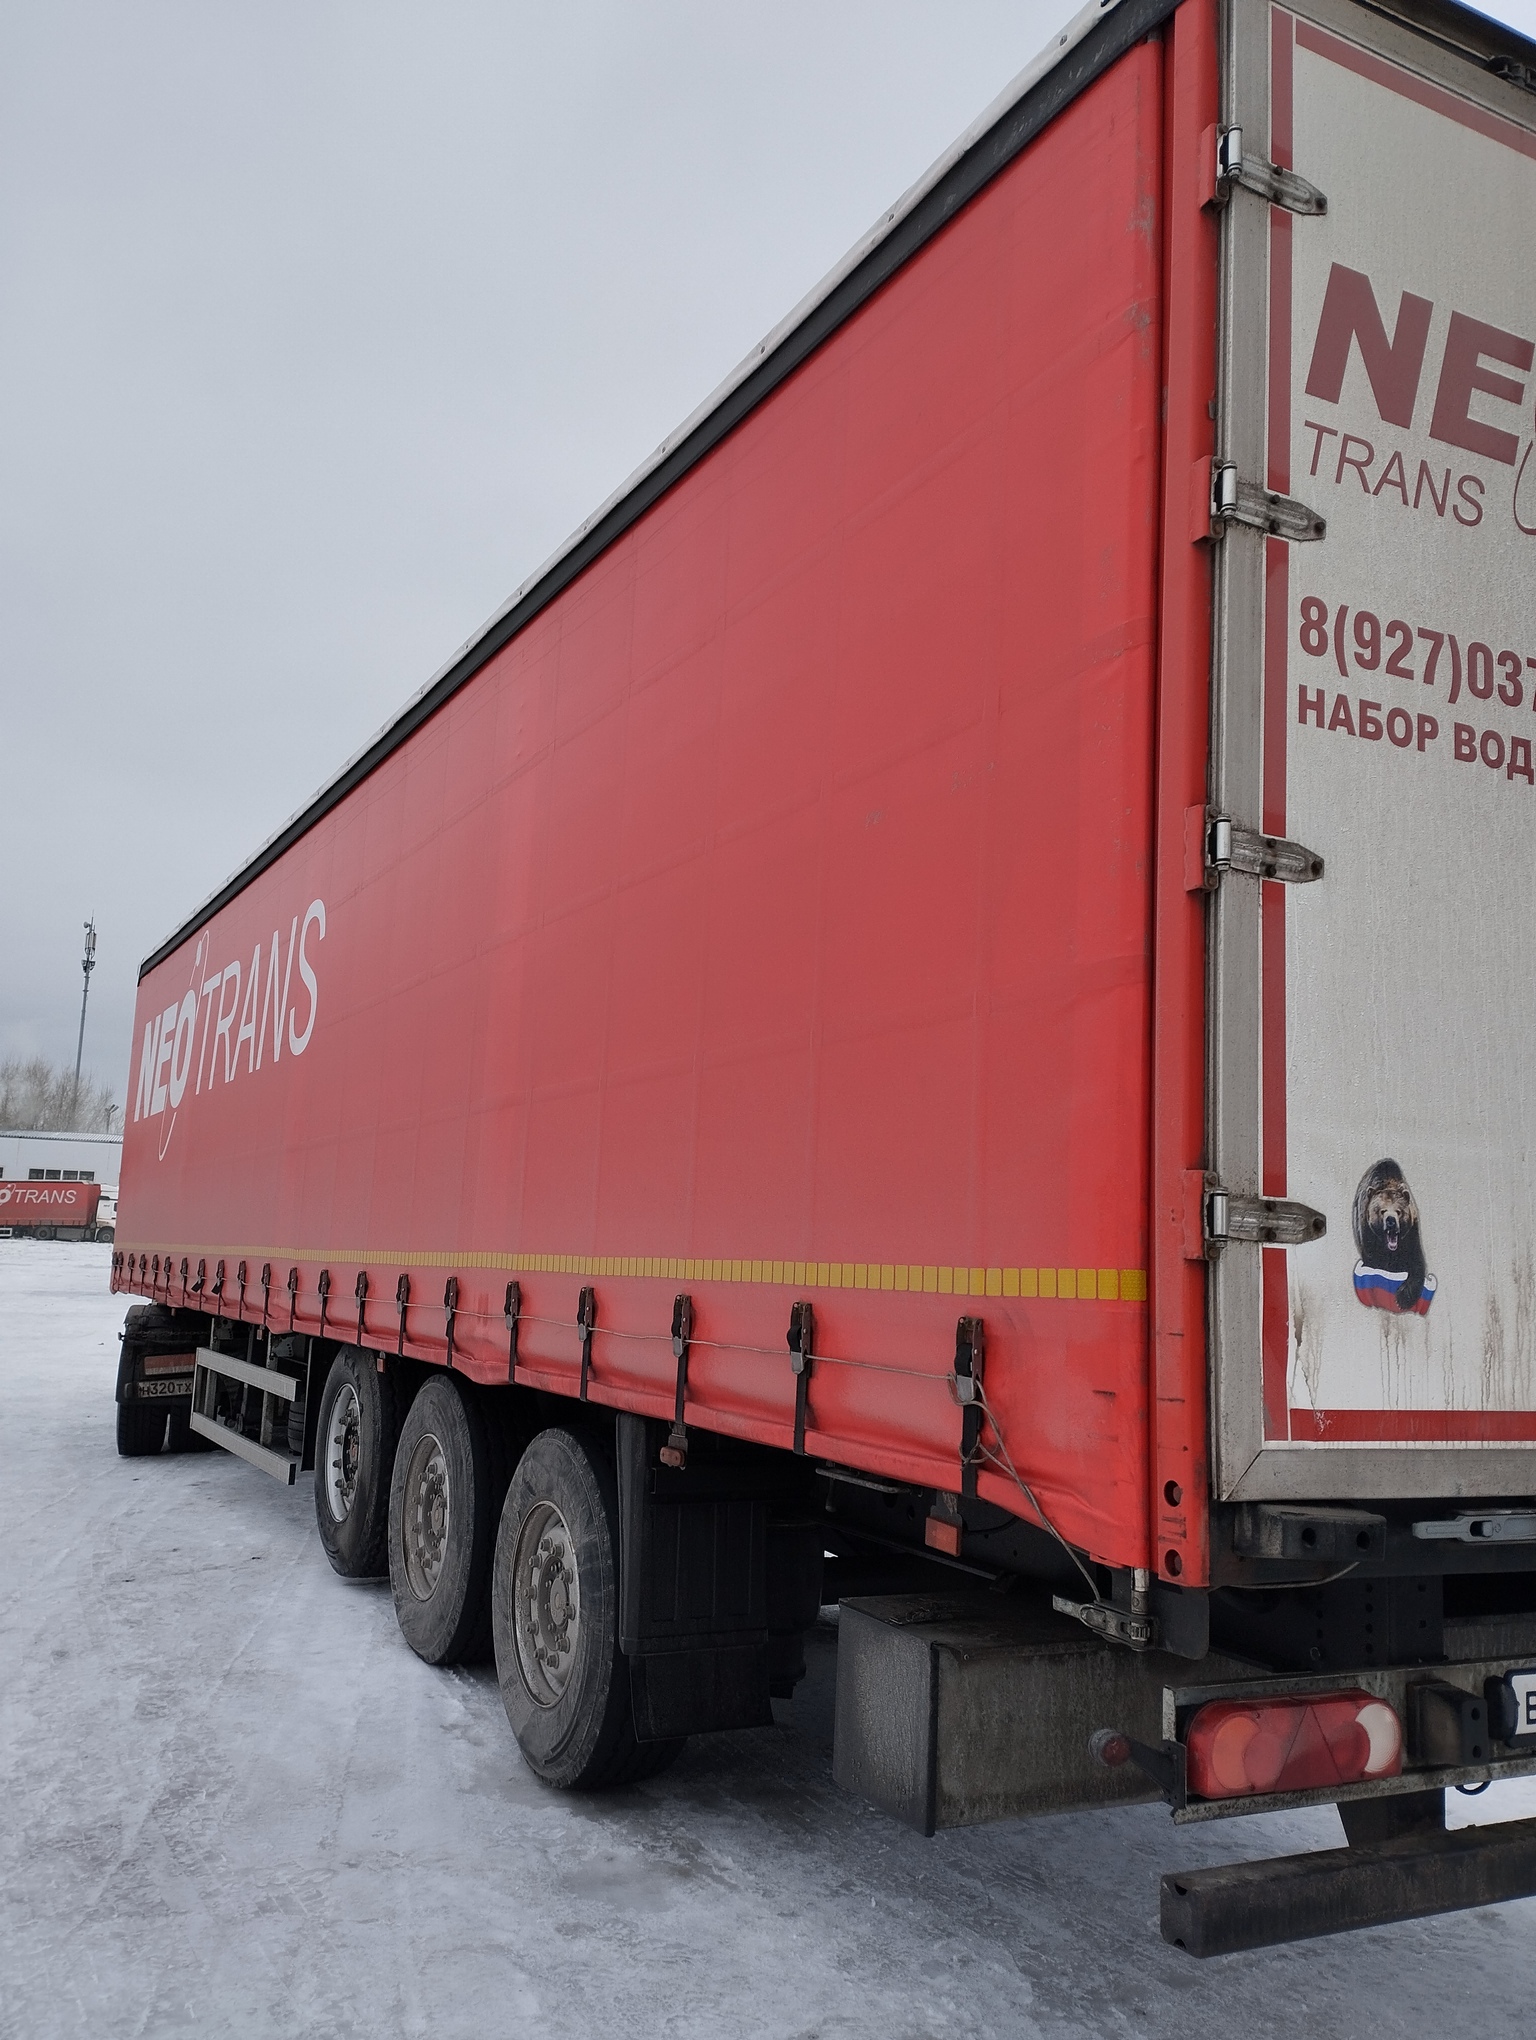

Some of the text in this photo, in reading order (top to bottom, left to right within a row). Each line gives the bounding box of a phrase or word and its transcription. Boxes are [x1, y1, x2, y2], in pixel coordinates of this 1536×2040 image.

[1303, 419, 1486, 527] TRANS
[1298, 683, 1535, 786] НАБОР ВОД
